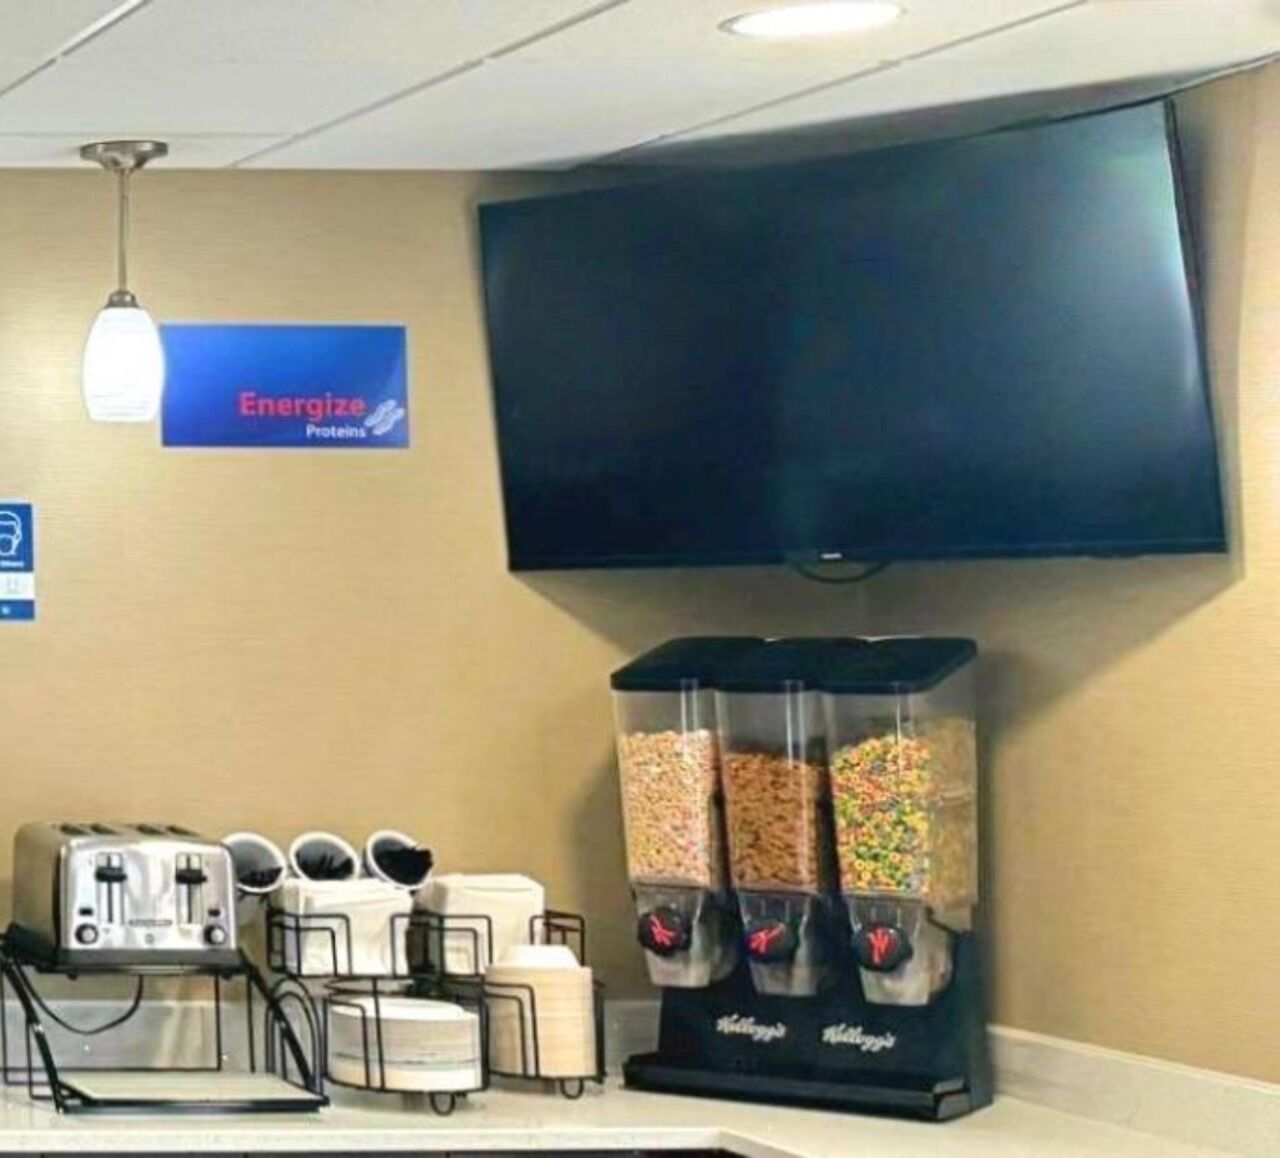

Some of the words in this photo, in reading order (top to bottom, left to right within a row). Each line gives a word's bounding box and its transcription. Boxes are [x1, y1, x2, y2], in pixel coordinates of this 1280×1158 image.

[239, 391, 366, 420] Energize
[306, 425, 366, 438] Proteins
[716, 1013, 787, 1042] Kellogg's
[821, 1023, 896, 1052] Kellogg's
